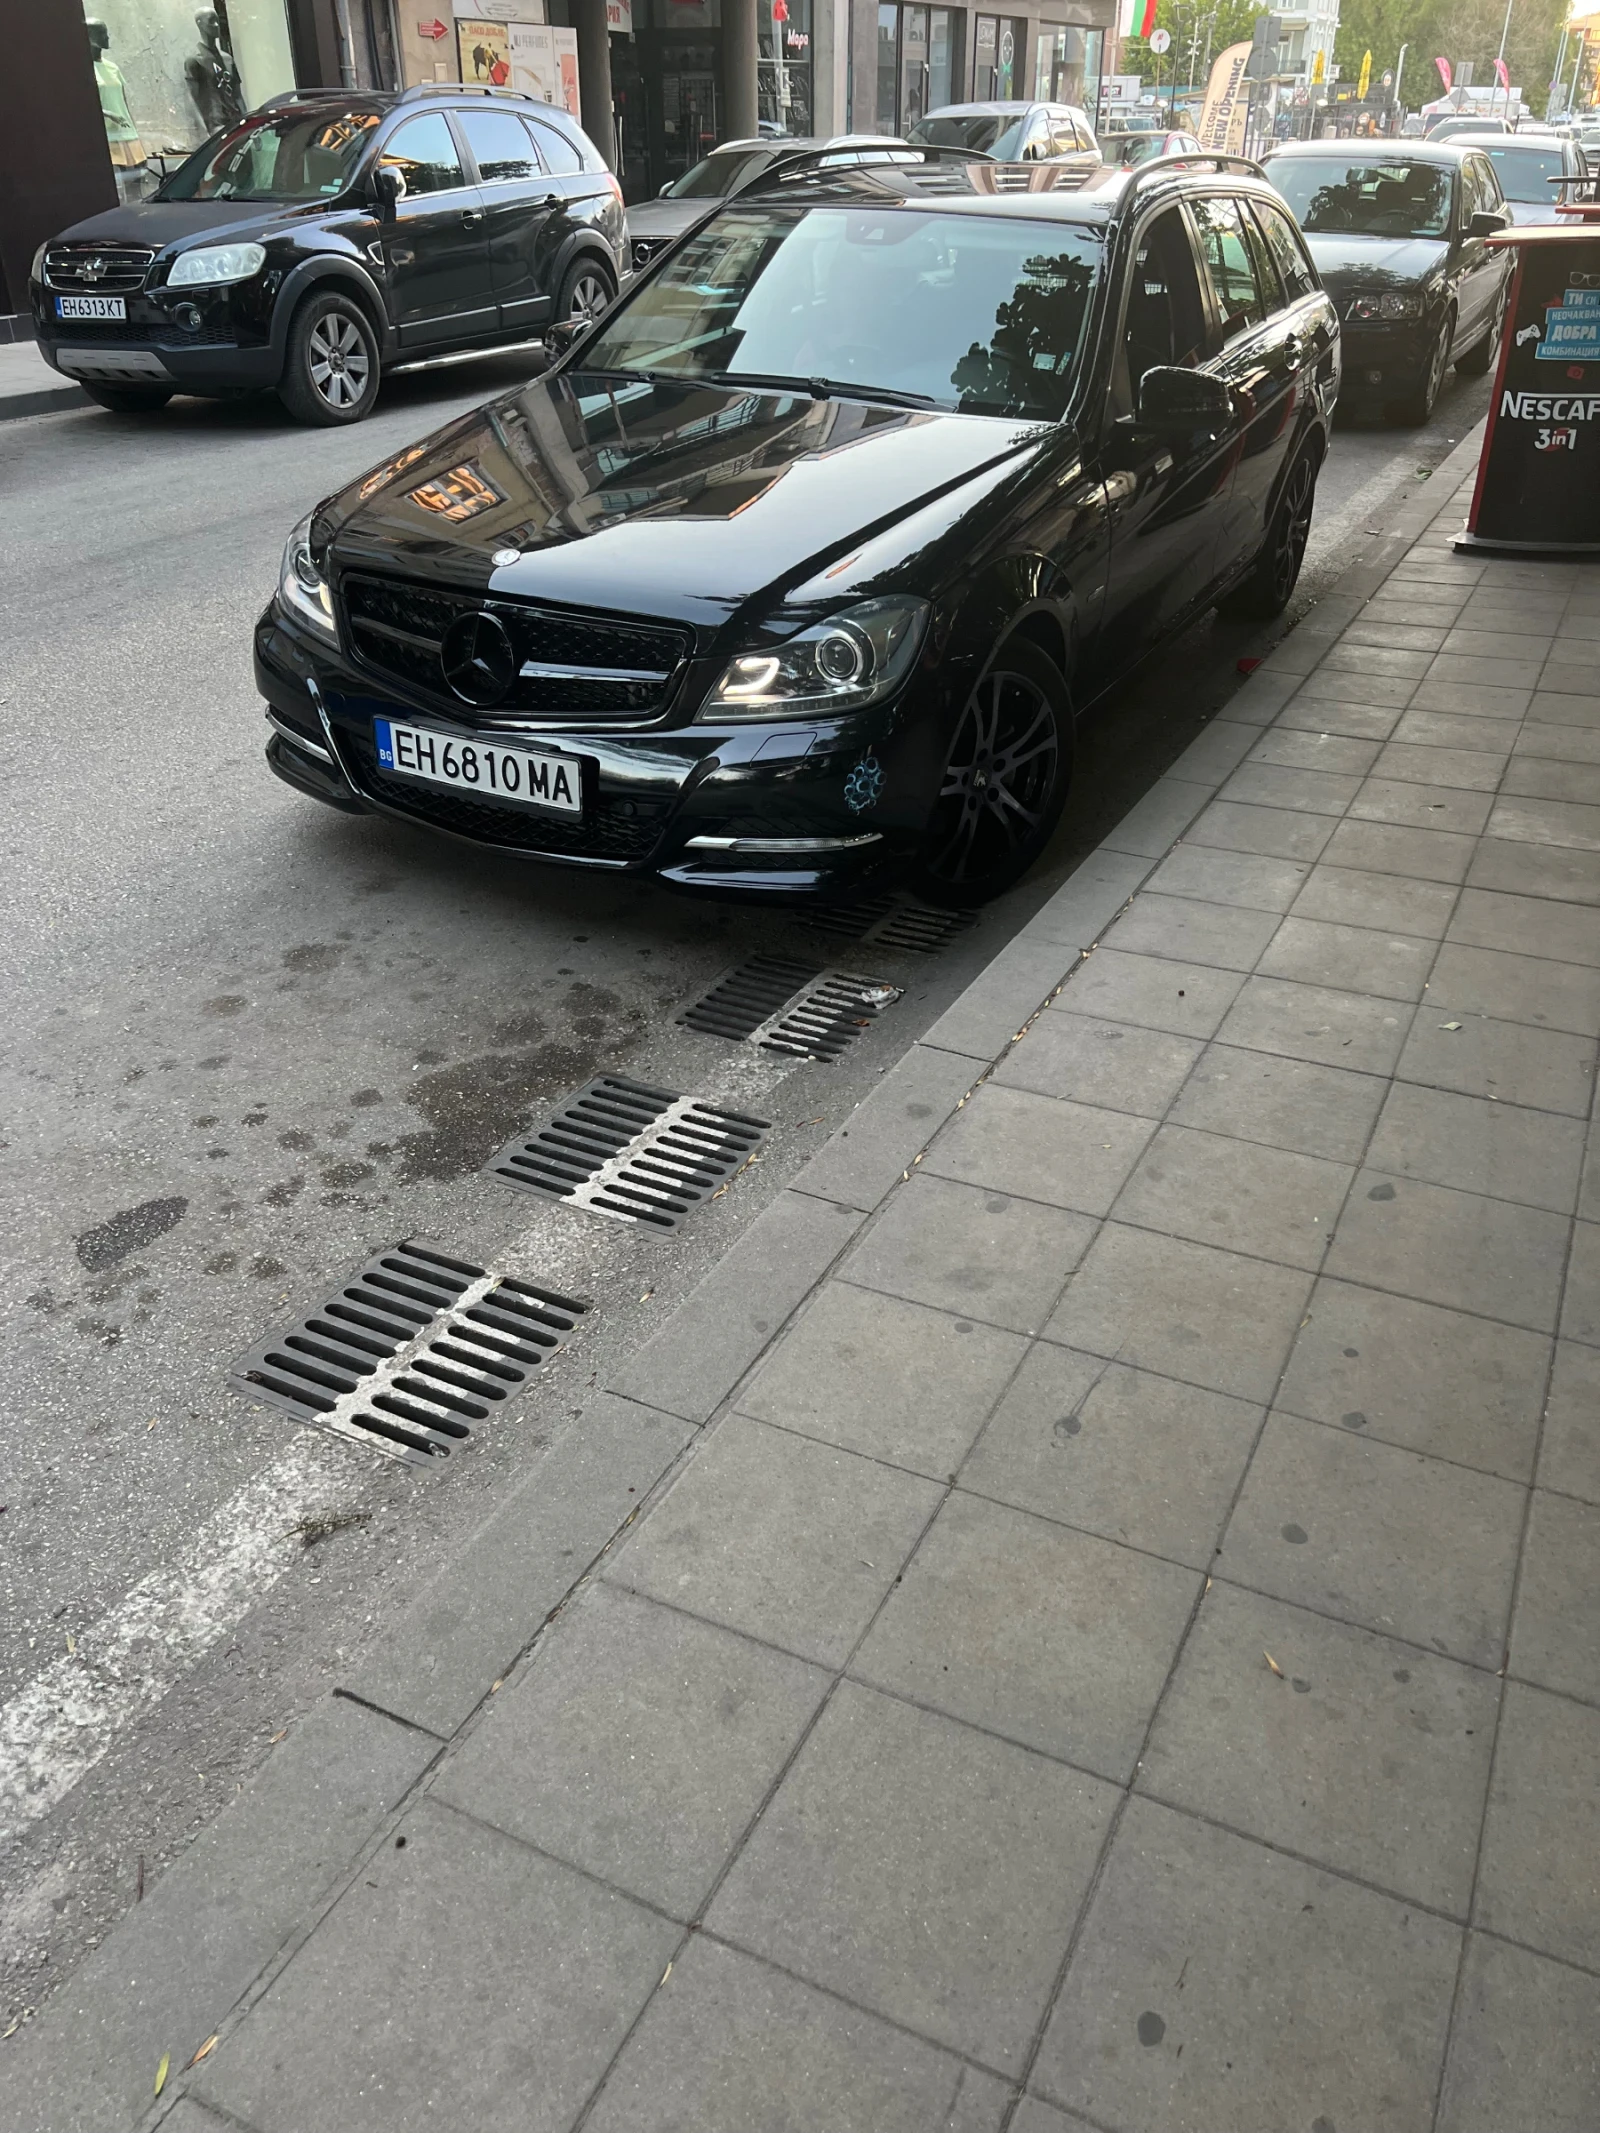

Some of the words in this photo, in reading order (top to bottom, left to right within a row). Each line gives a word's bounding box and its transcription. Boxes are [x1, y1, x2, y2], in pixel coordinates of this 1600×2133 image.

[1218, 57, 1246, 118] OPENING
[1200, 100, 1220, 148] WELCOME
[1211, 118, 1229, 150] NEW
[62, 298, 123, 317] EH6313KT
[1568, 292, 1584, 305] ТИ
[1551, 324, 1597, 342] ДОБРА
[1540, 345, 1600, 357] КОМБИНАЦИЯ
[1500, 390, 1600, 421] NESCAF
[1534, 427, 1577, 450] 3in1
[379, 748, 393, 761] BG
[394, 729, 573, 804] EH6810MA
